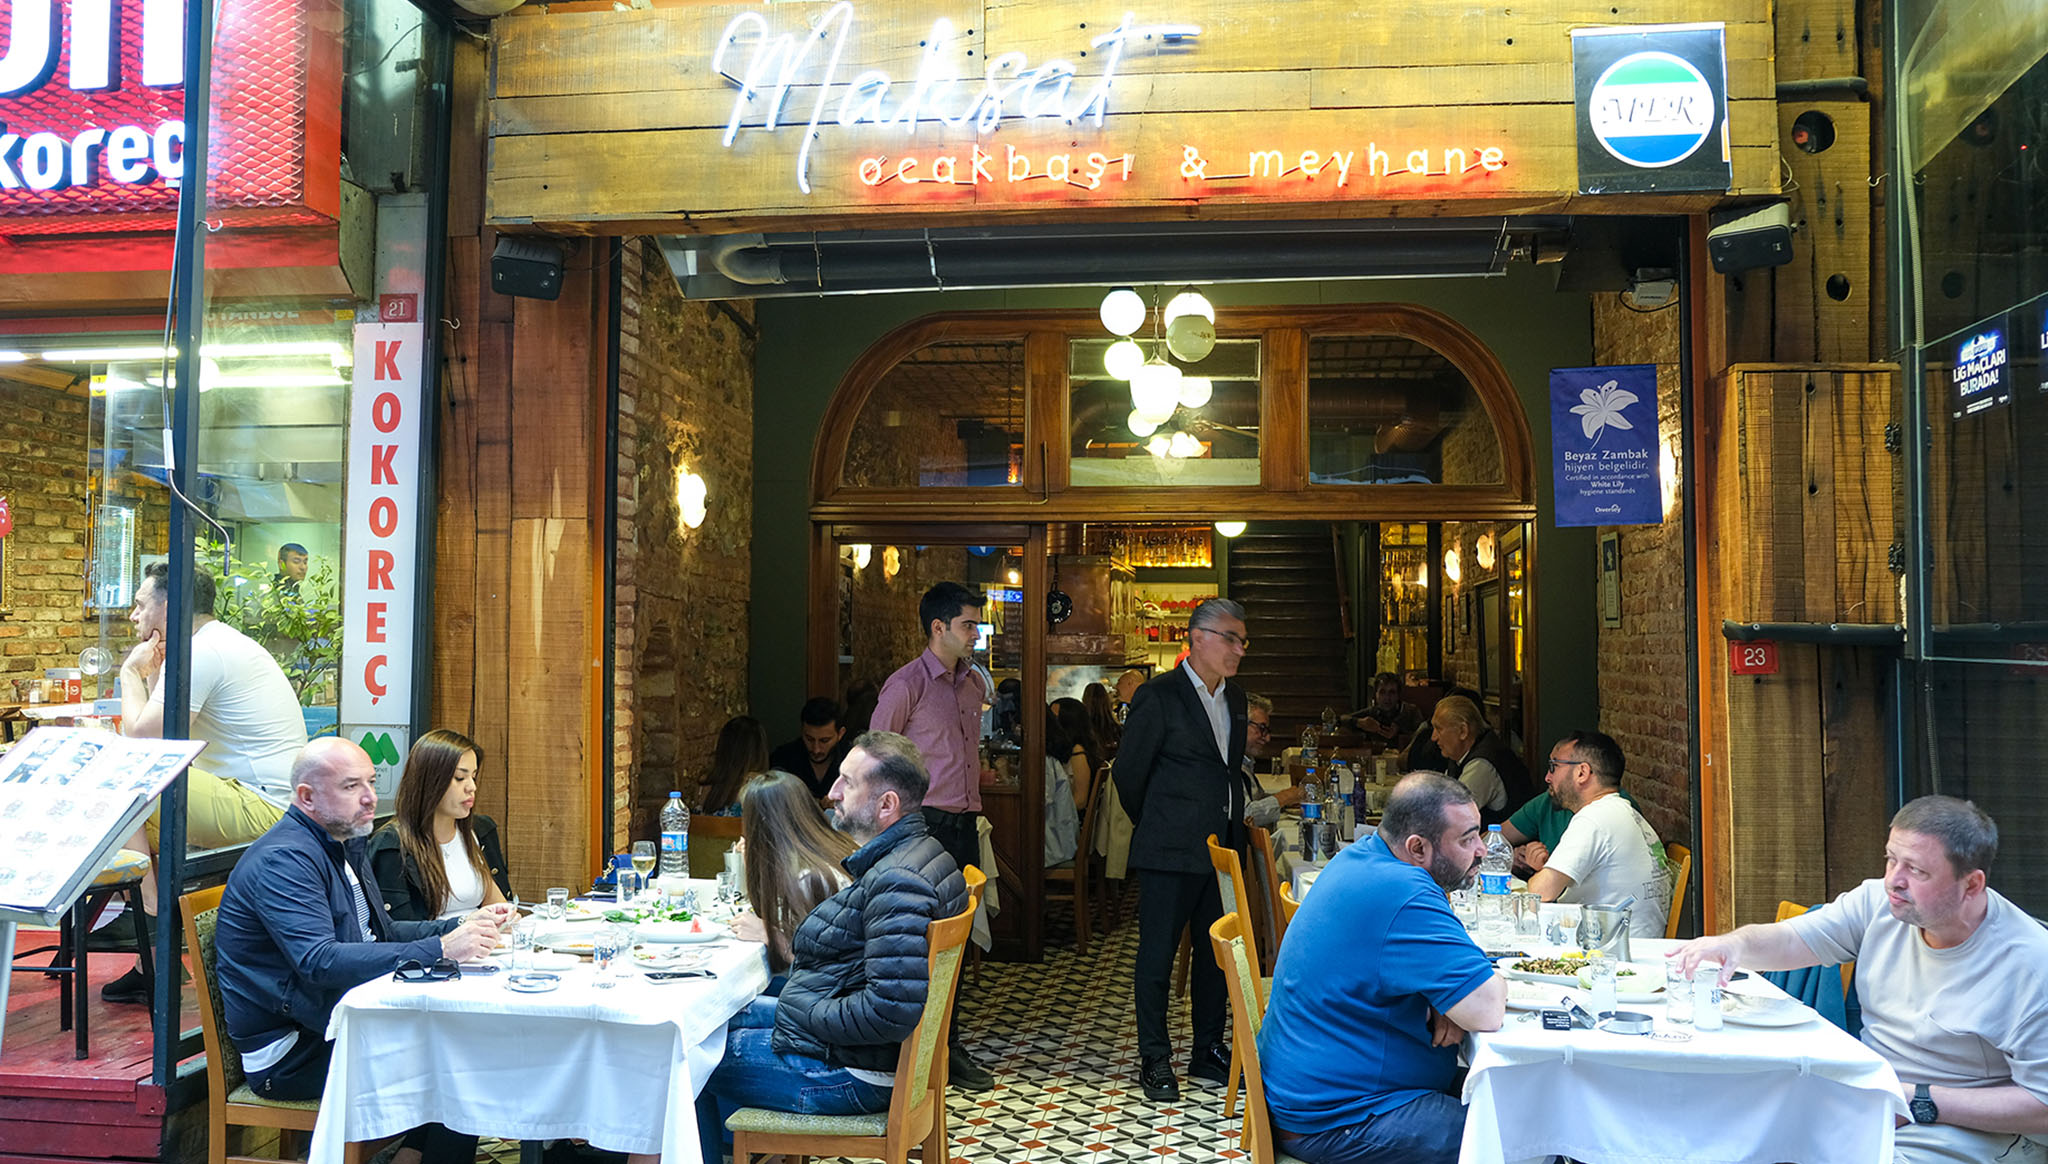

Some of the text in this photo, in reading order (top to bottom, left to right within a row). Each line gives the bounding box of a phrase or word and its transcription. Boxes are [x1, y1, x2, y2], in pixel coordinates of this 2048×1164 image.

[711, 1, 1200, 193] Maksat
[858, 142, 1507, 190] ocakbaşı & meyhane
[388, 302, 405, 317] 21
[1960, 369, 1999, 396] BURADA!
[1564, 448, 1648, 462] Beyaz Zambak
[1564, 460, 1648, 473] hijyen belgelidir.
[1565, 473, 1591, 481] Certified
[1579, 487, 1635, 496] hygiene standards
[1612, 480, 1624, 490] Lily
[363, 340, 402, 706] KOKOREÇ
[1744, 647, 1766, 666] 23
